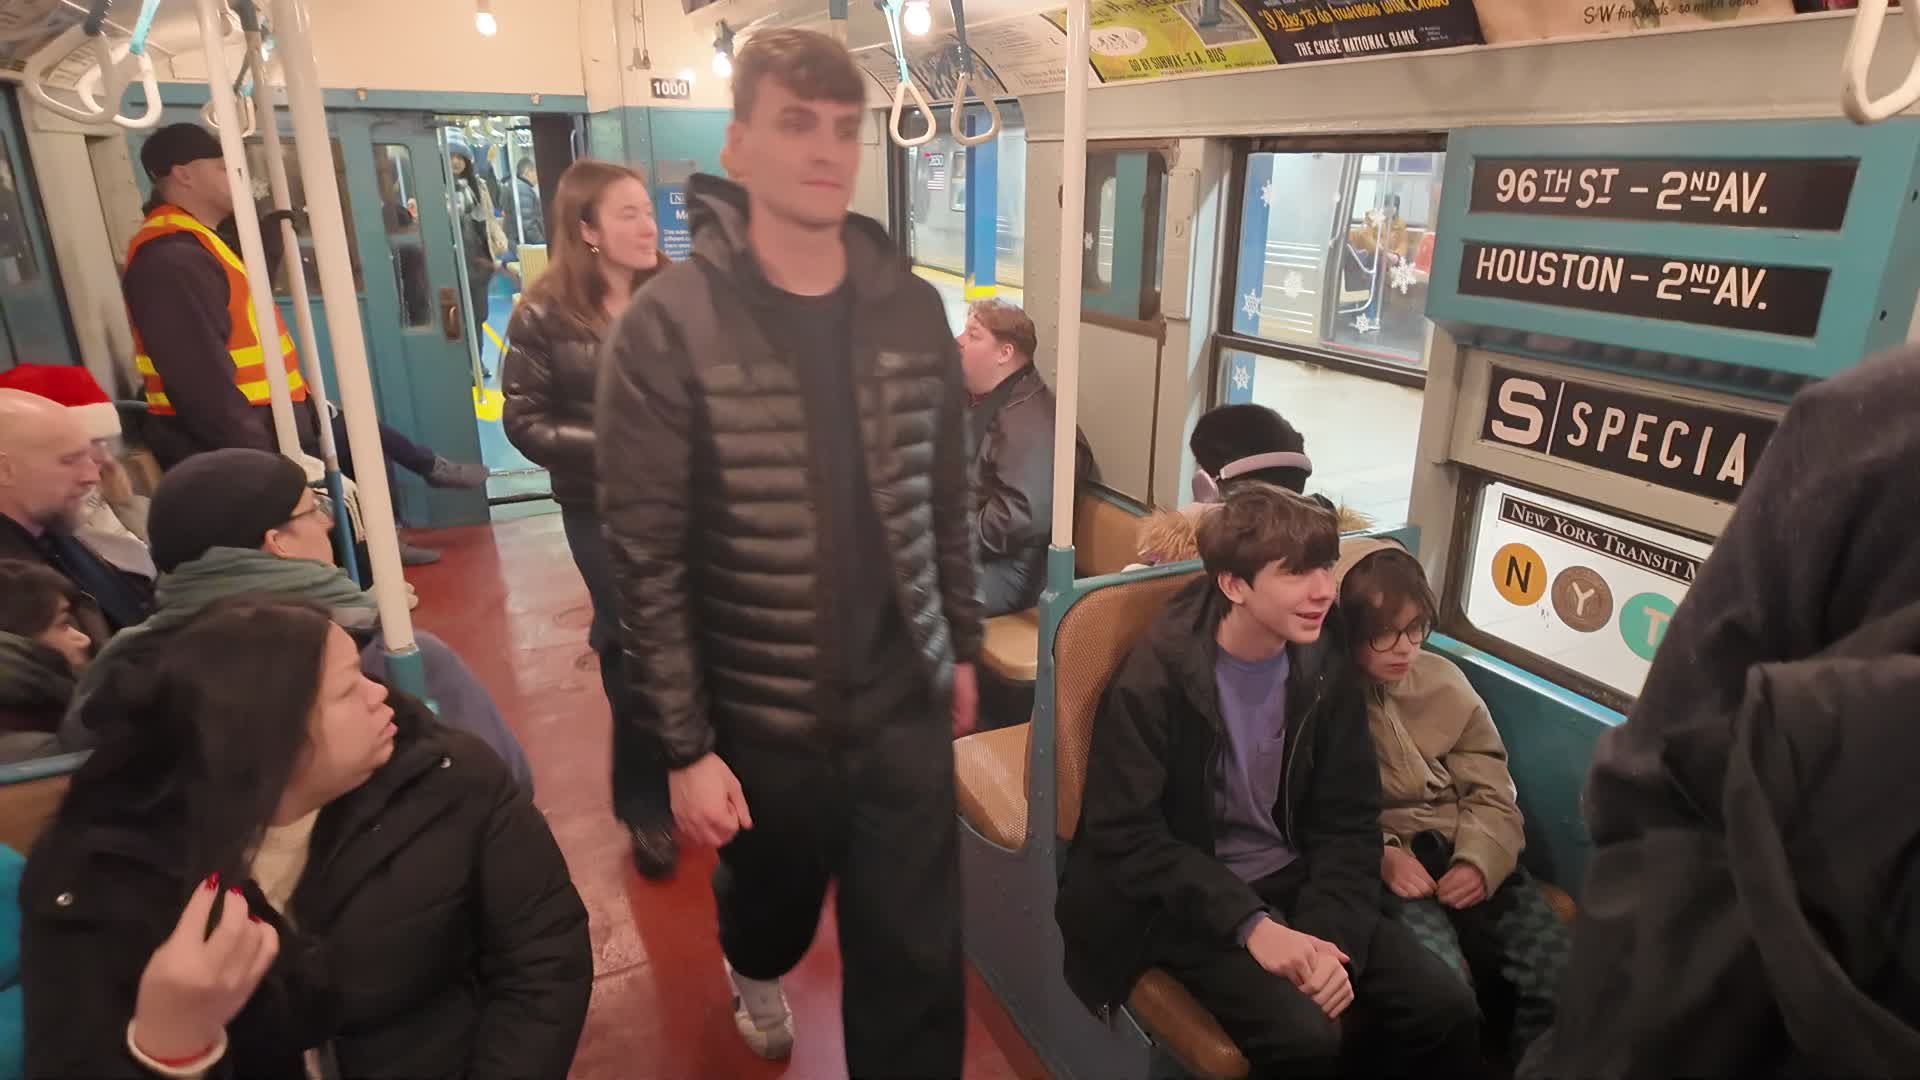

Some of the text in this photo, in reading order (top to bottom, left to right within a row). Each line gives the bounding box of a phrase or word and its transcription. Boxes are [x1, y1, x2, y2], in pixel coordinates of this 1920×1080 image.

[1315, 6, 1334, 23] do
[1129, 59, 1141, 72] GO
[1141, 58, 1152, 70] BY
[1206, 47, 1227, 63] BUS
[1294, 42, 1314, 57] THE
[1313, 38, 1342, 55] CHASE
[1343, 34, 1389, 53] NATIONAL
[1389, 29, 1419, 47] BANK
[654, 81, 688, 96] 1000
[1496, 168, 1572, 203] 96TH
[1576, 168, 1619, 208] ST
[1476, 247, 1625, 294] HOUSTON
[1491, 377, 1748, 486] S SPECIA
[1505, 555, 1672, 647] N Y T
